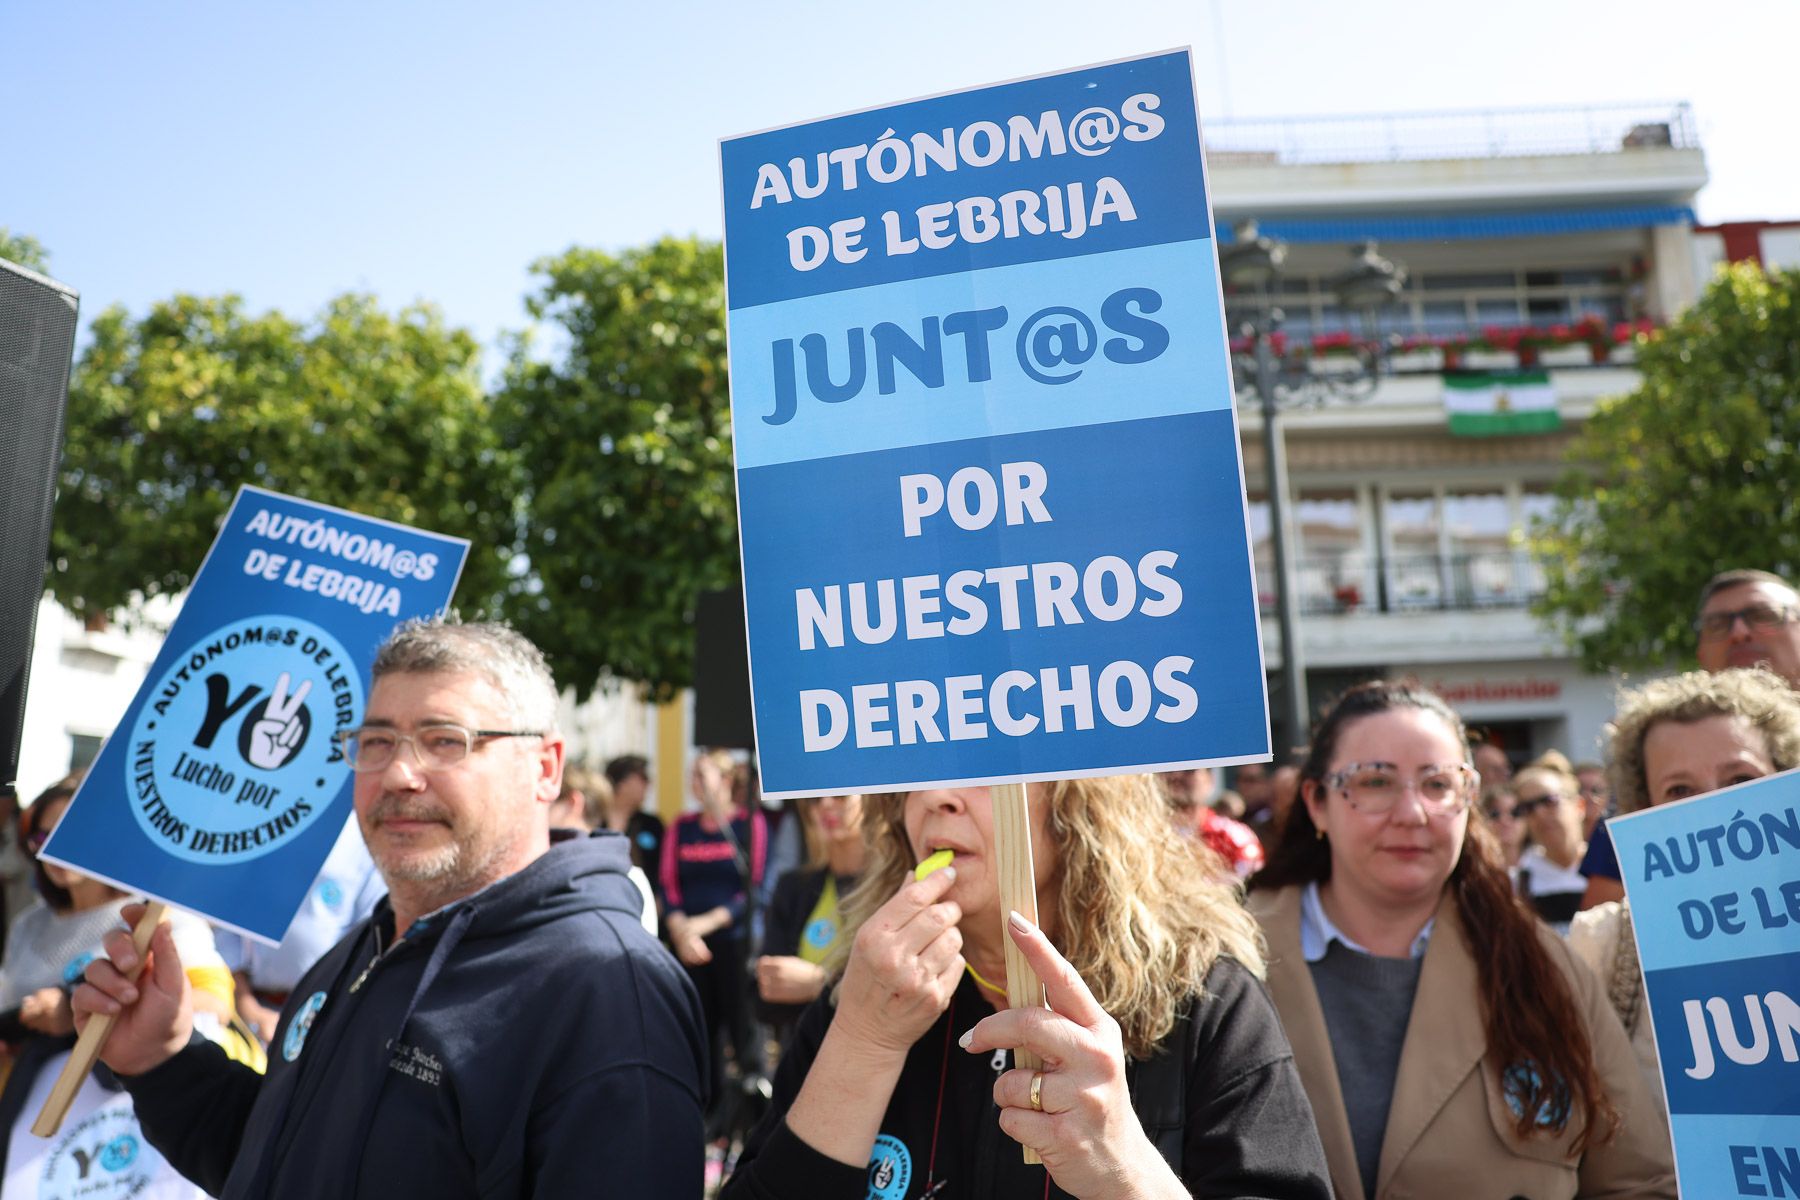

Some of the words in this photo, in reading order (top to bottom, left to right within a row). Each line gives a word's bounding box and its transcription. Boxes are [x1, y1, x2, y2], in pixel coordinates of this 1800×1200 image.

[750, 92, 1165, 210] AUTÓNOM@S
[786, 216, 868, 271] DE
[881, 177, 1137, 257] LEBRIJA
[761, 287, 1170, 426] JUNT@S
[245, 509, 439, 581] AUTÓNOM@S
[900, 461, 1053, 537] POR
[244, 549, 287, 581] DE
[284, 559, 401, 617] LEBRIJA
[796, 550, 1183, 650] NUESTROS
[153, 626, 299, 717] AUTÓNOM@S
[301, 637, 332, 666] DE
[800, 655, 1199, 753] DERECHOS
[134, 740, 190, 845] NUESTROS
[190, 797, 313, 855] DERECHOS
[171, 752, 235, 795] Lucho
[235, 776, 281, 810] por
[1677, 892, 1746, 940] DE
